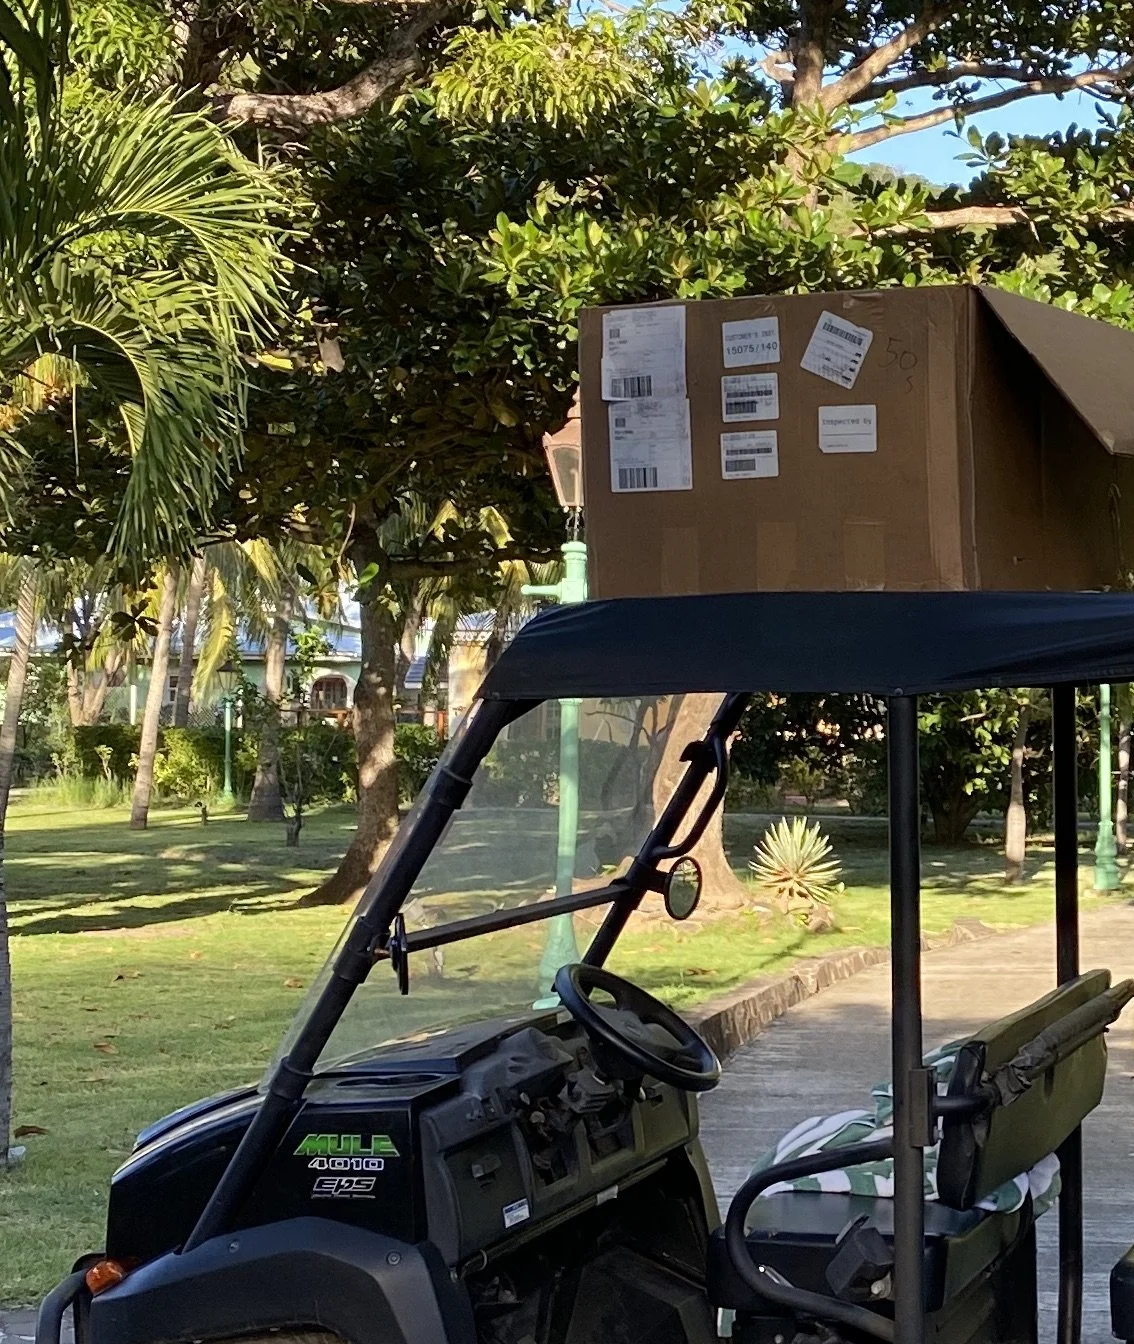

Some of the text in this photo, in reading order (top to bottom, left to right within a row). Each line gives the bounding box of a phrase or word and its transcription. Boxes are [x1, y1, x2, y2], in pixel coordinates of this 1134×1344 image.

[726, 341, 778, 355] 15075/140
[293, 1133, 401, 1157] MULE
[308, 1157, 385, 1171] 4010
